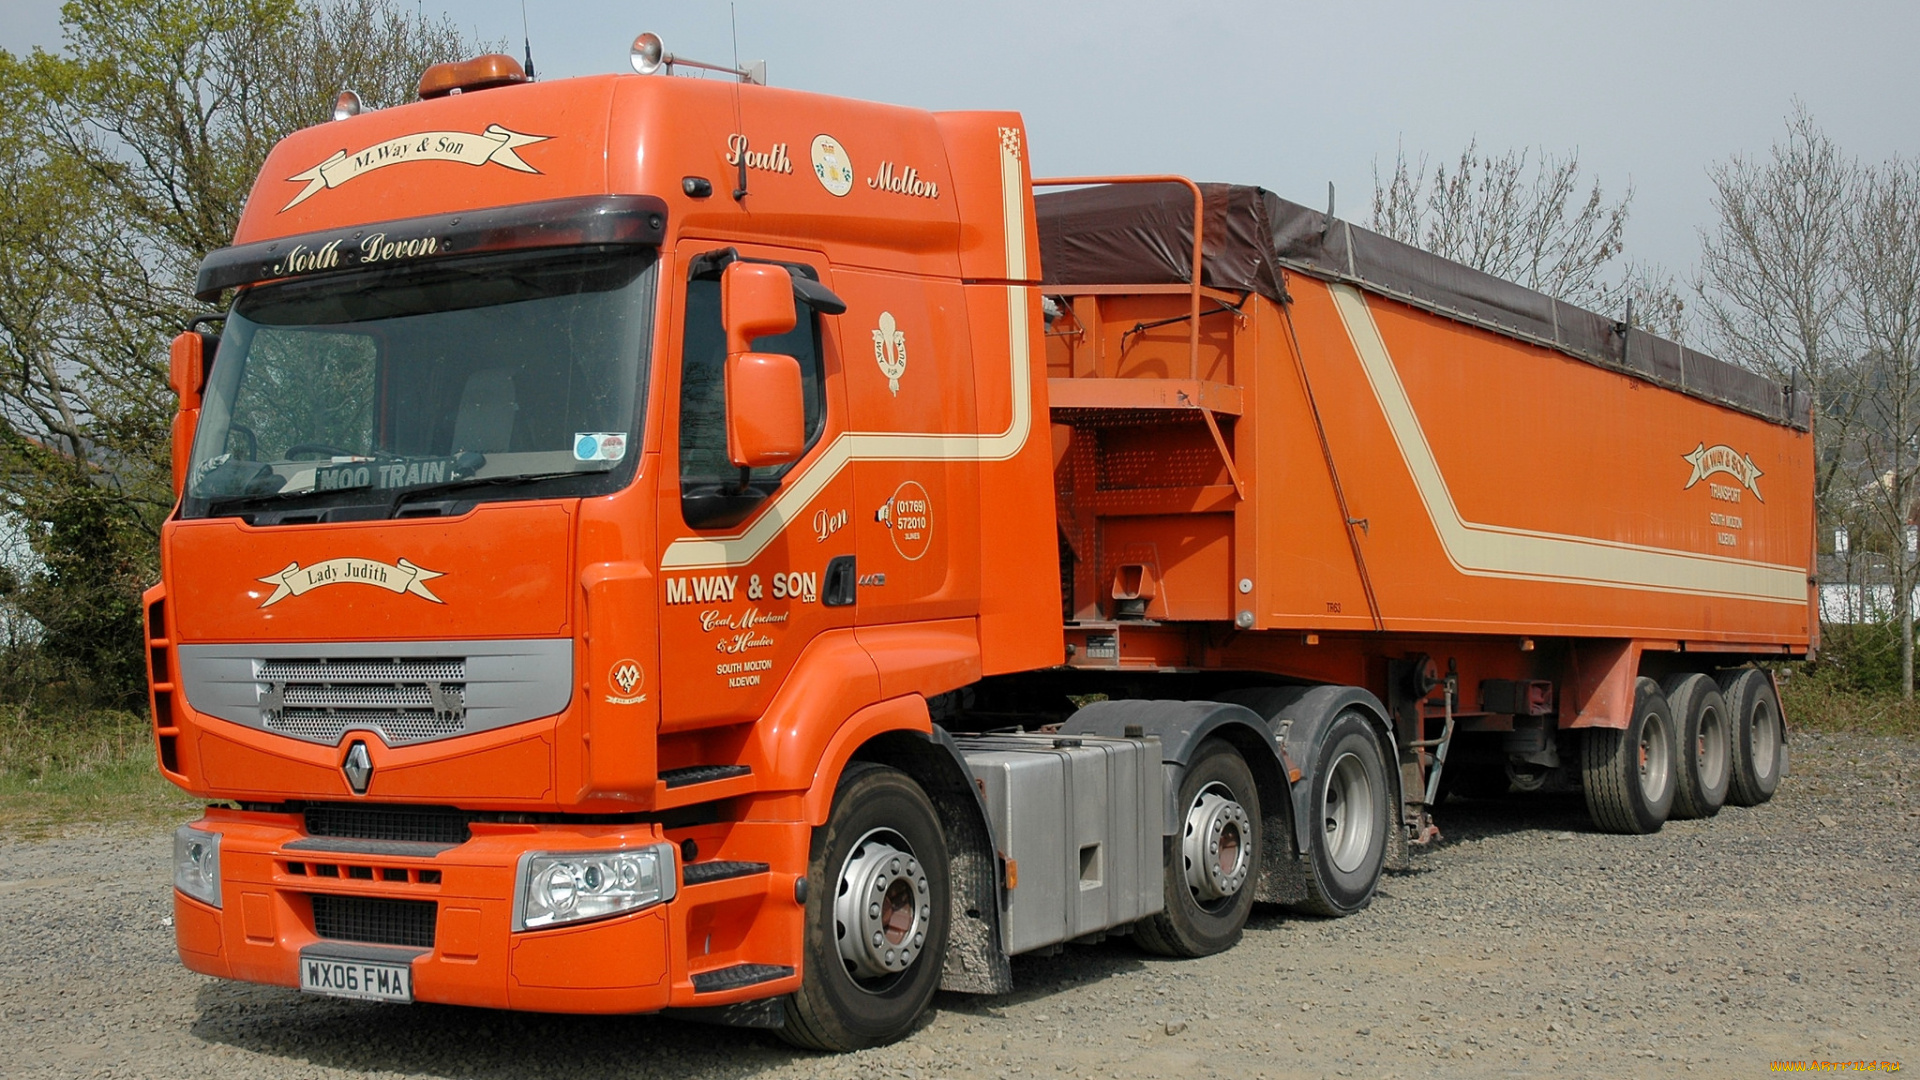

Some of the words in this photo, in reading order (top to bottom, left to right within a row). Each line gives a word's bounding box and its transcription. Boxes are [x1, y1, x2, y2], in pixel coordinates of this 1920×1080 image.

[353, 142, 409, 171] M.Way
[416, 136, 430, 153] &
[435, 135, 465, 155] Son
[726, 133, 793, 175] South
[867, 160, 940, 199] Molton
[273, 238, 345, 275] North
[360, 231, 438, 264] Devon
[875, 341, 885, 364] WAY
[320, 466, 370, 491] MOO
[379, 461, 446, 489] TRAIN
[1709, 482, 1741, 503] TRANSPORT
[896, 499, 927, 517] (01769)
[813, 508, 849, 543] Den
[897, 516, 927, 530] 572010
[307, 564, 339, 586] Lady
[344, 562, 388, 583] Judith
[666, 575, 739, 605] M.WAY
[747, 573, 764, 600] &
[772, 571, 817, 600] SON
[802, 594, 817, 603] LTD
[700, 609, 732, 632] Coal
[729, 607, 789, 630] Merchant
[716, 638, 727, 653] &
[727, 631, 774, 654] Haulier
[716, 662, 742, 675] SOUTH
[743, 659, 773, 673] MOLTON
[308, 961, 359, 991] WX06
[363, 967, 403, 996] FMA
